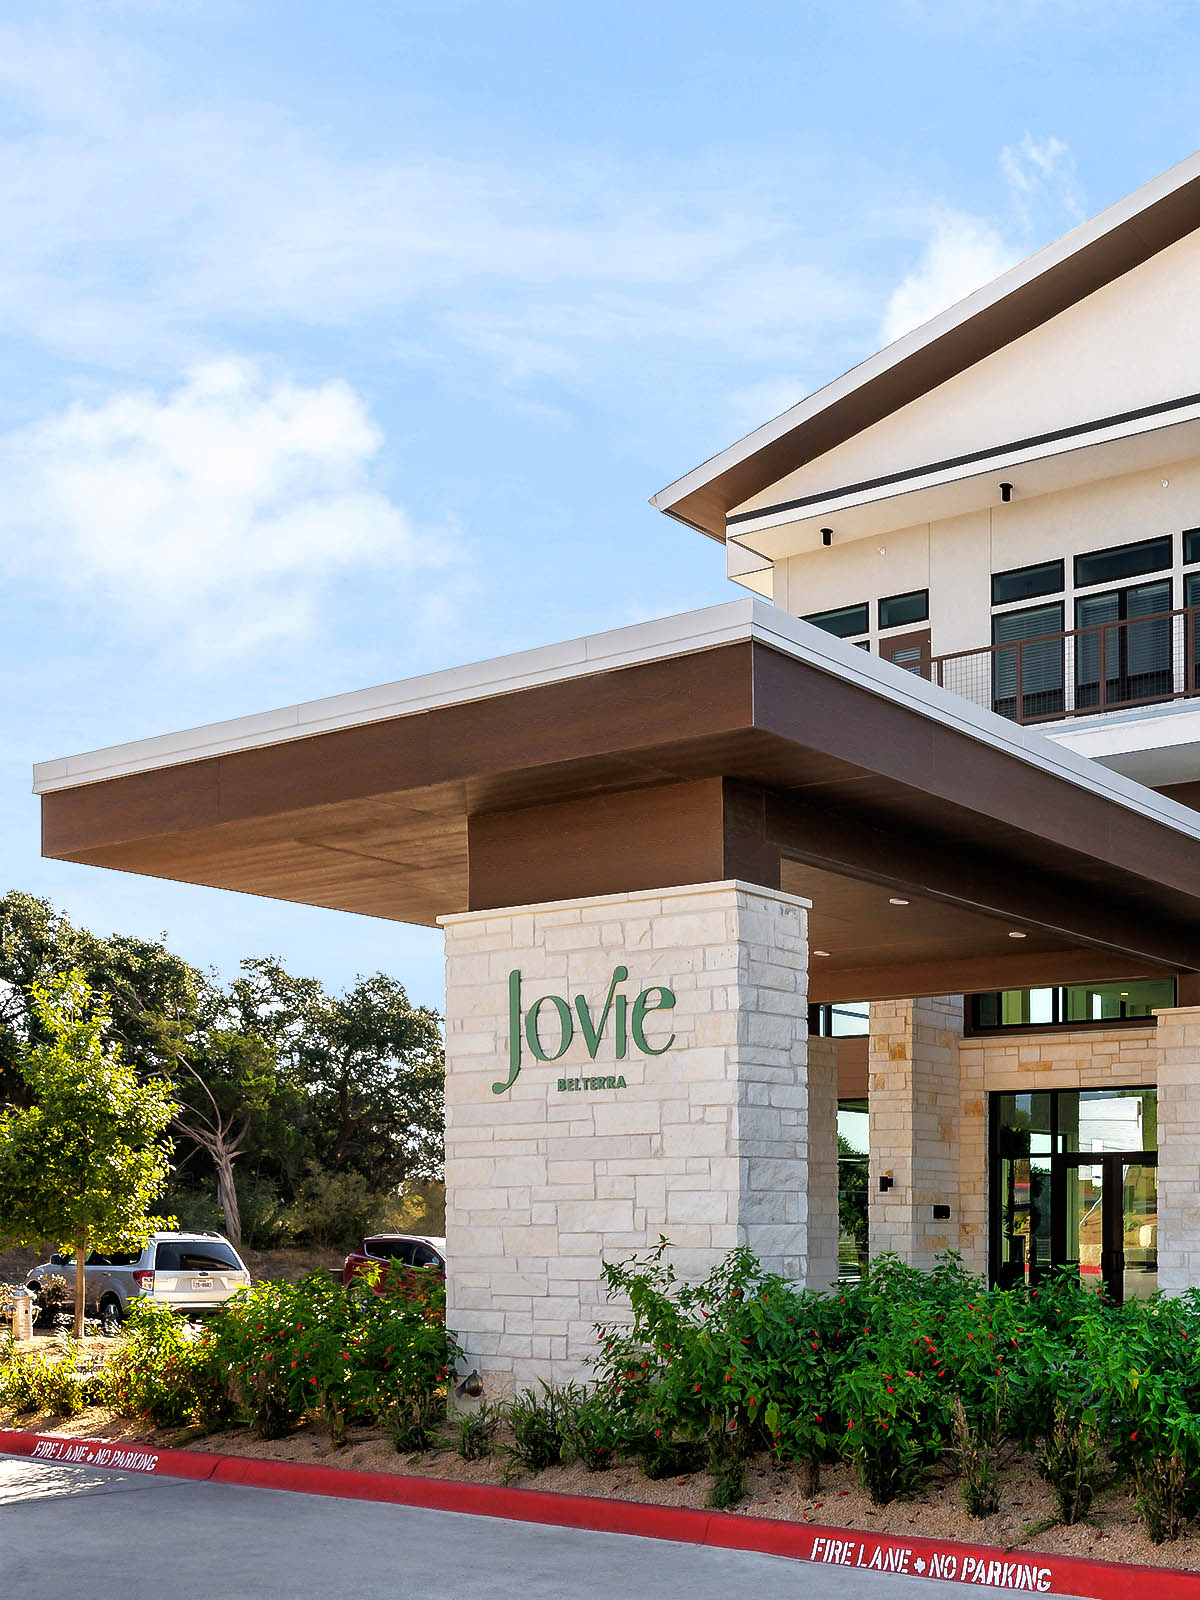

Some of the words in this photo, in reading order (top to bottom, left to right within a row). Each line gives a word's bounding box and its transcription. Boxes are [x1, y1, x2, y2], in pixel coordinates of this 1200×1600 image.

[492, 965, 676, 1094] Jovie
[557, 1075, 627, 1092] BELTERRA
[31, 1440, 59, 1459] FIRE
[55, 1443, 88, 1462] LANE
[93, 1448, 112, 1464] NO
[108, 1450, 158, 1471] PARKING
[811, 1537, 855, 1566] FIRE
[857, 1544, 912, 1574] LANE
[929, 1553, 957, 1579] NO
[960, 1557, 1052, 1592] PARKING
